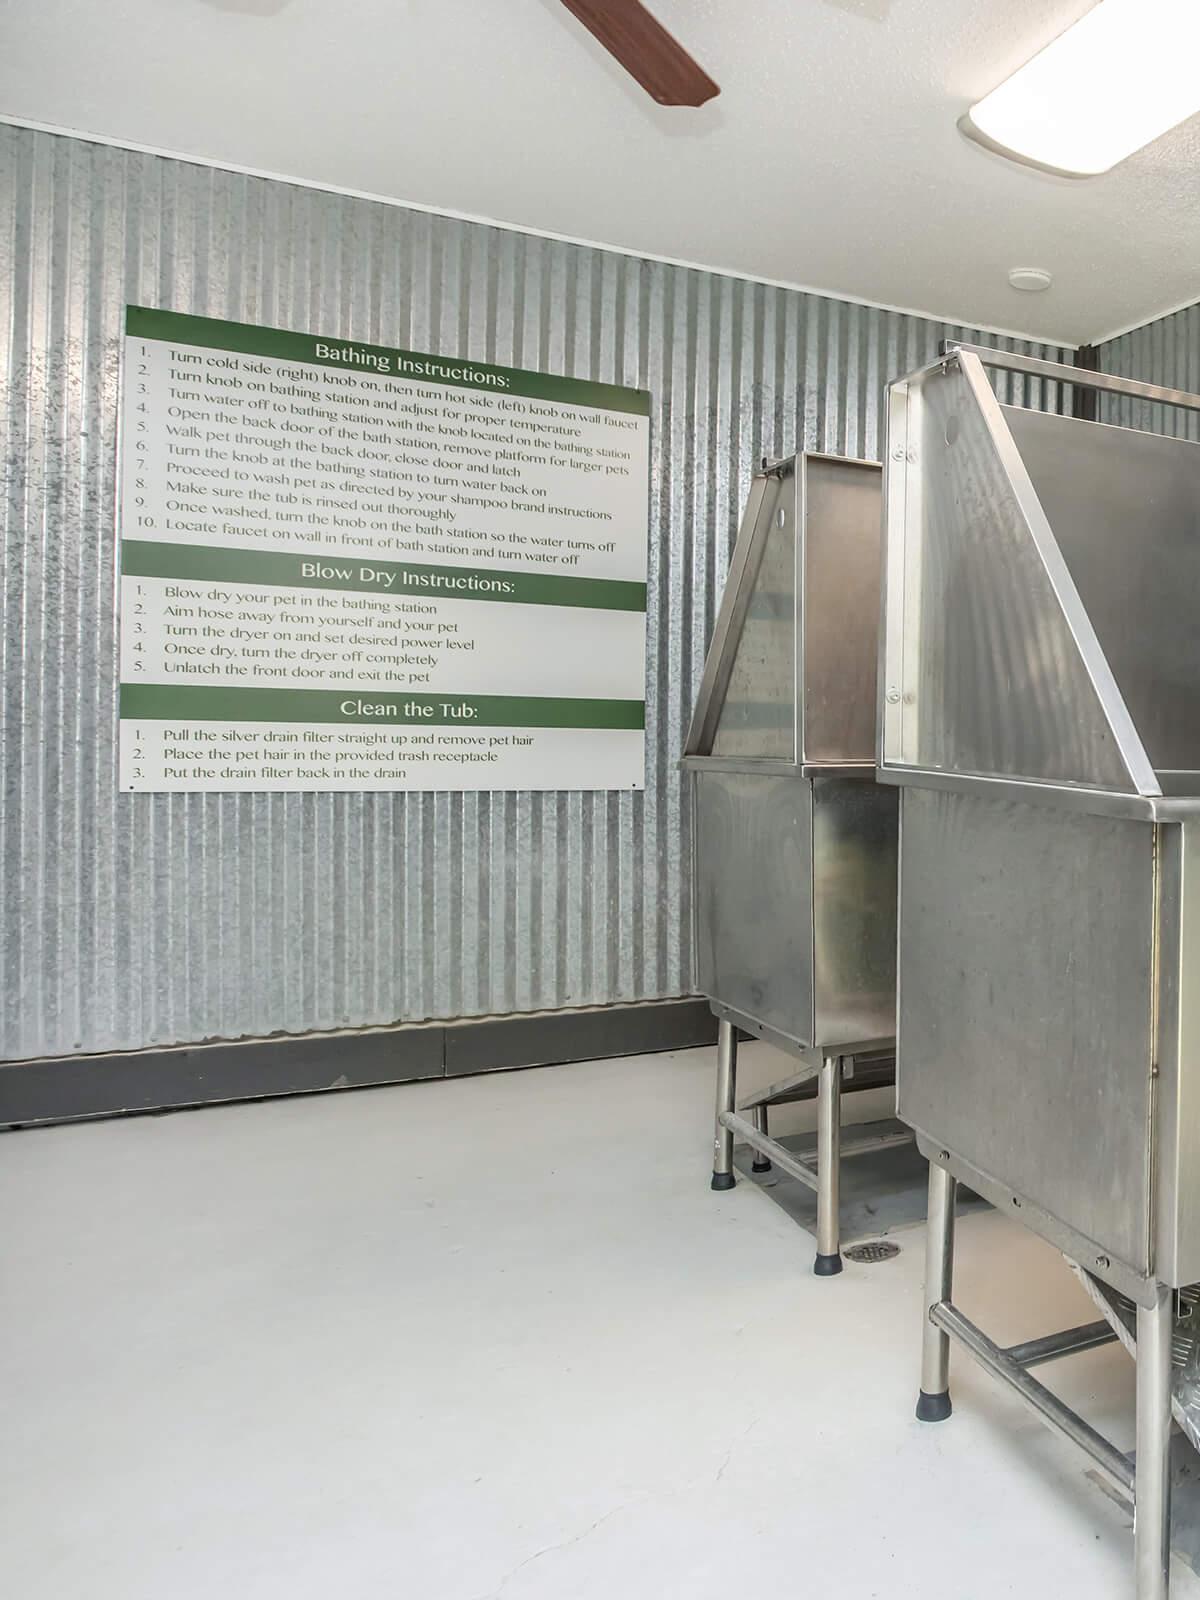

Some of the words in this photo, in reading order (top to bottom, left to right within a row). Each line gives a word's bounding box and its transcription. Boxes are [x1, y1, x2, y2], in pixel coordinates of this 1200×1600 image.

[315, 344, 392, 372] Bathing
[397, 356, 511, 388] Instructions:
[137, 364, 150, 377] 2.
[170, 368, 202, 383] Turn
[206, 372, 243, 388] knob
[246, 382, 266, 392] on
[269, 381, 321, 403] bathing
[324, 393, 370, 407] station
[373, 399, 398, 411] and
[400, 403, 438, 417] adjust
[442, 407, 462, 420] for
[464, 413, 507, 427] proper
[509, 419, 582, 437] temperature
[141, 345, 151, 358] 1.
[169, 350, 202, 365] Turn
[206, 357, 239, 370] cold
[242, 361, 272, 375] side
[276, 366, 319, 383] (right)
[323, 372, 357, 387] knob
[384, 382, 413, 396] then
[416, 388, 442, 401] turn
[445, 391, 465, 404] hot
[469, 396, 494, 408] side
[497, 399, 526, 414] (left)
[529, 403, 559, 418] knob
[560, 411, 576, 421] on
[578, 414, 601, 425] wall
[604, 415, 638, 431] faucet
[137, 421, 149, 433] 5.
[165, 424, 202, 439] Walk
[206, 431, 230, 443] pet
[235, 432, 291, 451] through
[295, 439, 317, 453] the
[321, 442, 354, 458] back
[394, 452, 429, 466] close
[432, 457, 464, 470] door
[466, 463, 489, 474] and
[492, 463, 521, 478] latch
[136, 458, 148, 471] 7.
[167, 462, 230, 479] Proceed
[234, 470, 250, 481] to
[253, 473, 290, 486] wash
[294, 478, 316, 489] pet
[320, 481, 336, 490] as
[338, 480, 395, 497] directed
[398, 486, 414, 501] by
[417, 491, 448, 503] your
[450, 493, 508, 510] shampoo
[511, 499, 545, 513] brand
[548, 503, 613, 521] instructions
[138, 515, 157, 529] 10.
[166, 519, 217, 533] Locate
[222, 522, 268, 538] faucet
[271, 530, 291, 540] on
[294, 530, 321, 542] wall
[325, 535, 337, 544] in
[341, 533, 373, 547] front
[377, 538, 394, 548] of
[396, 538, 424, 552] bath
[427, 543, 469, 556] station
[472, 547, 495, 558] and
[498, 549, 522, 560] turn
[524, 552, 559, 564] water
[560, 554, 580, 566] off
[301, 562, 353, 580] Blow
[359, 567, 397, 588] Dry
[403, 571, 515, 593] Instructions:
[136, 584, 147, 596] 1.
[165, 586, 201, 599] Blow
[207, 588, 232, 601] dry
[236, 593, 270, 603] your
[273, 595, 296, 607] pet
[300, 594, 313, 607] in
[316, 595, 338, 608] the
[342, 597, 391, 615] bathing
[394, 601, 437, 615] station
[134, 603, 147, 615] 2.
[164, 604, 194, 617] Aim
[198, 606, 234, 620] hose
[238, 612, 275, 622] away
[279, 611, 315, 624] from
[318, 616, 375, 628] yourself
[376, 618, 402, 630] and
[404, 621, 435, 633] your
[437, 623, 458, 634] pet
[134, 622, 147, 634] 3.
[164, 624, 198, 636] Turn
[202, 625, 225, 638] the
[229, 626, 270, 642] dryer
[272, 632, 292, 641] on
[295, 631, 321, 643] and
[324, 634, 344, 644] set
[348, 633, 398, 647] desired
[401, 639, 443, 649] power
[446, 638, 475, 651] level
[132, 641, 146, 653] 4.
[164, 643, 206, 656] Once
[241, 647, 270, 658] turn
[274, 647, 297, 660] the
[300, 648, 338, 661] dryer
[341, 650, 364, 662] off
[365, 653, 439, 666] completely
[134, 660, 146, 672] 5.
[164, 661, 221, 674] Unlatch
[225, 663, 248, 676] the
[253, 664, 287, 677] front
[291, 666, 326, 678] door
[328, 668, 354, 680] and
[357, 671, 381, 681] exit
[385, 669, 405, 682] the
[408, 672, 430, 684] pet
[340, 699, 398, 716] Clean
[404, 701, 434, 717] the
[438, 702, 478, 719] Tub:
[135, 729, 145, 741] 1.
[163, 728, 189, 741] Pull
[194, 729, 217, 741] the
[221, 729, 260, 742] silver
[263, 730, 299, 743] drain
[303, 731, 335, 743] filter
[337, 732, 387, 747] straight
[391, 735, 408, 747] up
[410, 733, 435, 745] and
[437, 736, 486, 745] remove
[489, 736, 509, 748] pet
[512, 735, 534, 746] hair
[132, 748, 145, 760] 2.
[164, 747, 204, 760] Place
[208, 748, 232, 760] the
[235, 750, 259, 763] pet
[263, 748, 290, 760] hair
[293, 748, 306, 760] in
[310, 749, 331, 761] the
[335, 749, 394, 763] provided
[398, 750, 430, 761] trash
[433, 751, 498, 764] receptacle
[132, 767, 145, 779] 3.
[164, 767, 188, 778] Put
[192, 766, 216, 778] the
[220, 766, 257, 778] drain
[261, 766, 294, 778] filter
[297, 767, 330, 778] back
[333, 767, 345, 778] in
[349, 767, 370, 778] the
[373, 767, 407, 779] drain
